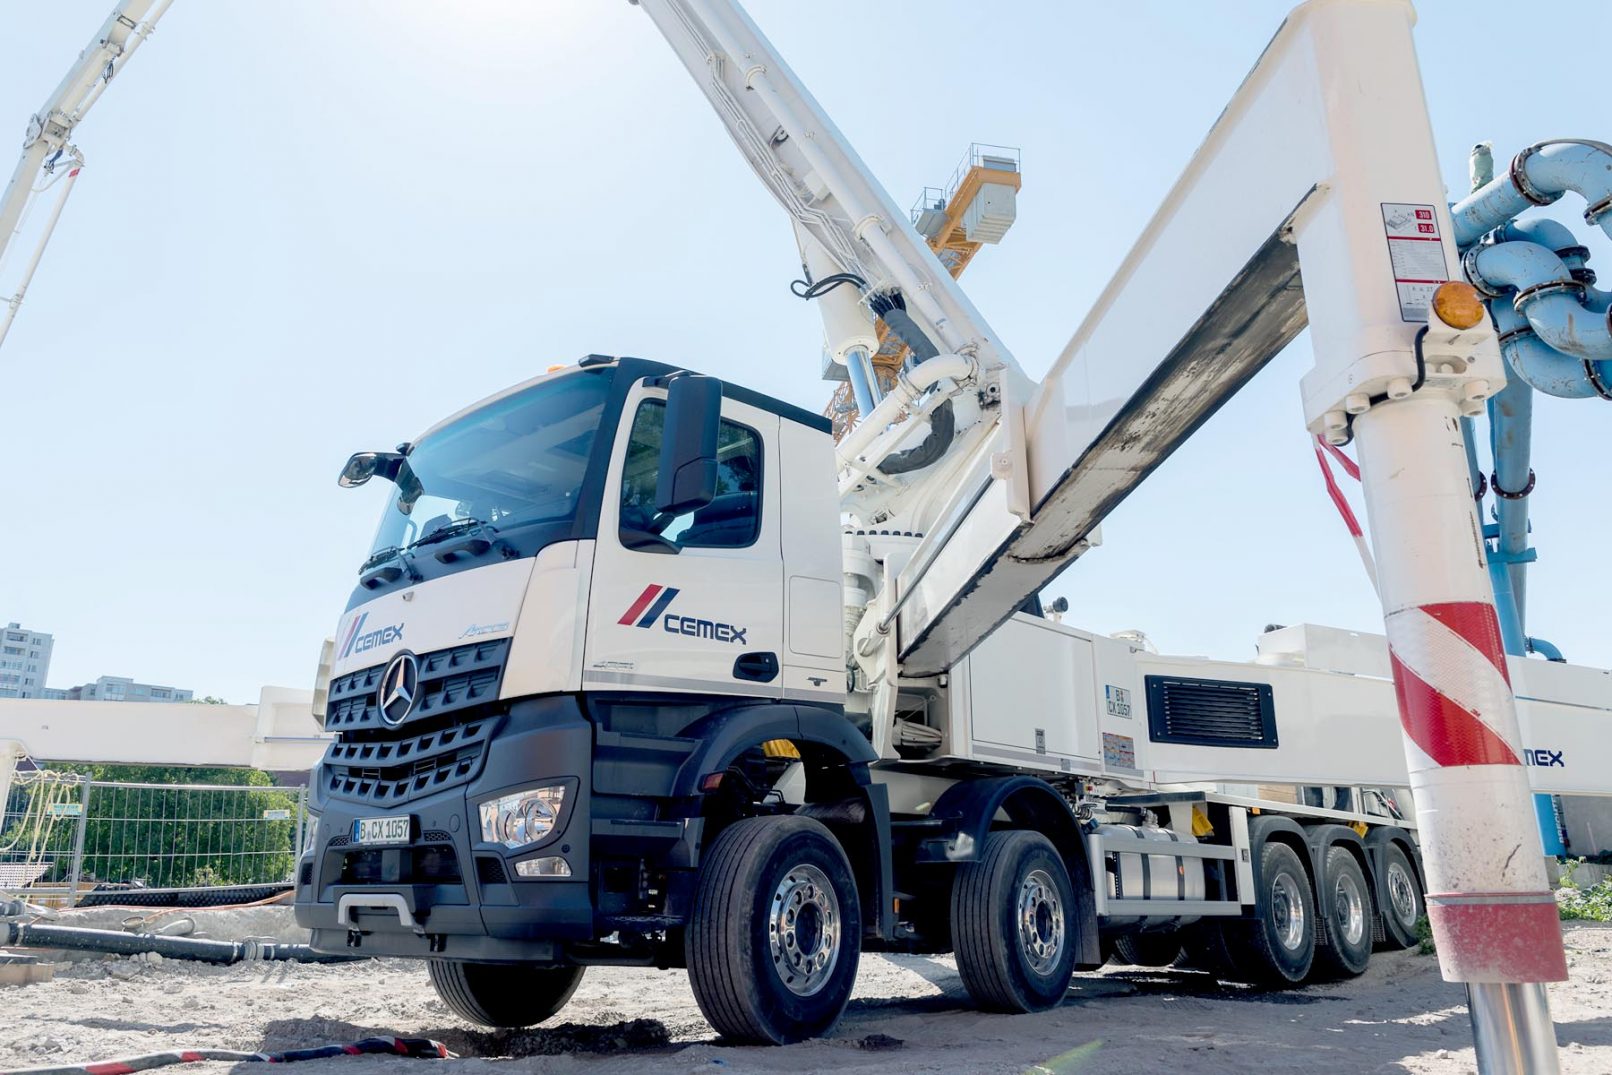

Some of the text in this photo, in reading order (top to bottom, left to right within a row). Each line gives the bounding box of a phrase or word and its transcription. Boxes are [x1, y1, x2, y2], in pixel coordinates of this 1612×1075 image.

[354, 622, 405, 653] CEMEX
[664, 614, 747, 645] CEMEX
[1523, 749, 1565, 767] MEX
[360, 819, 409, 840] B CX 1057
